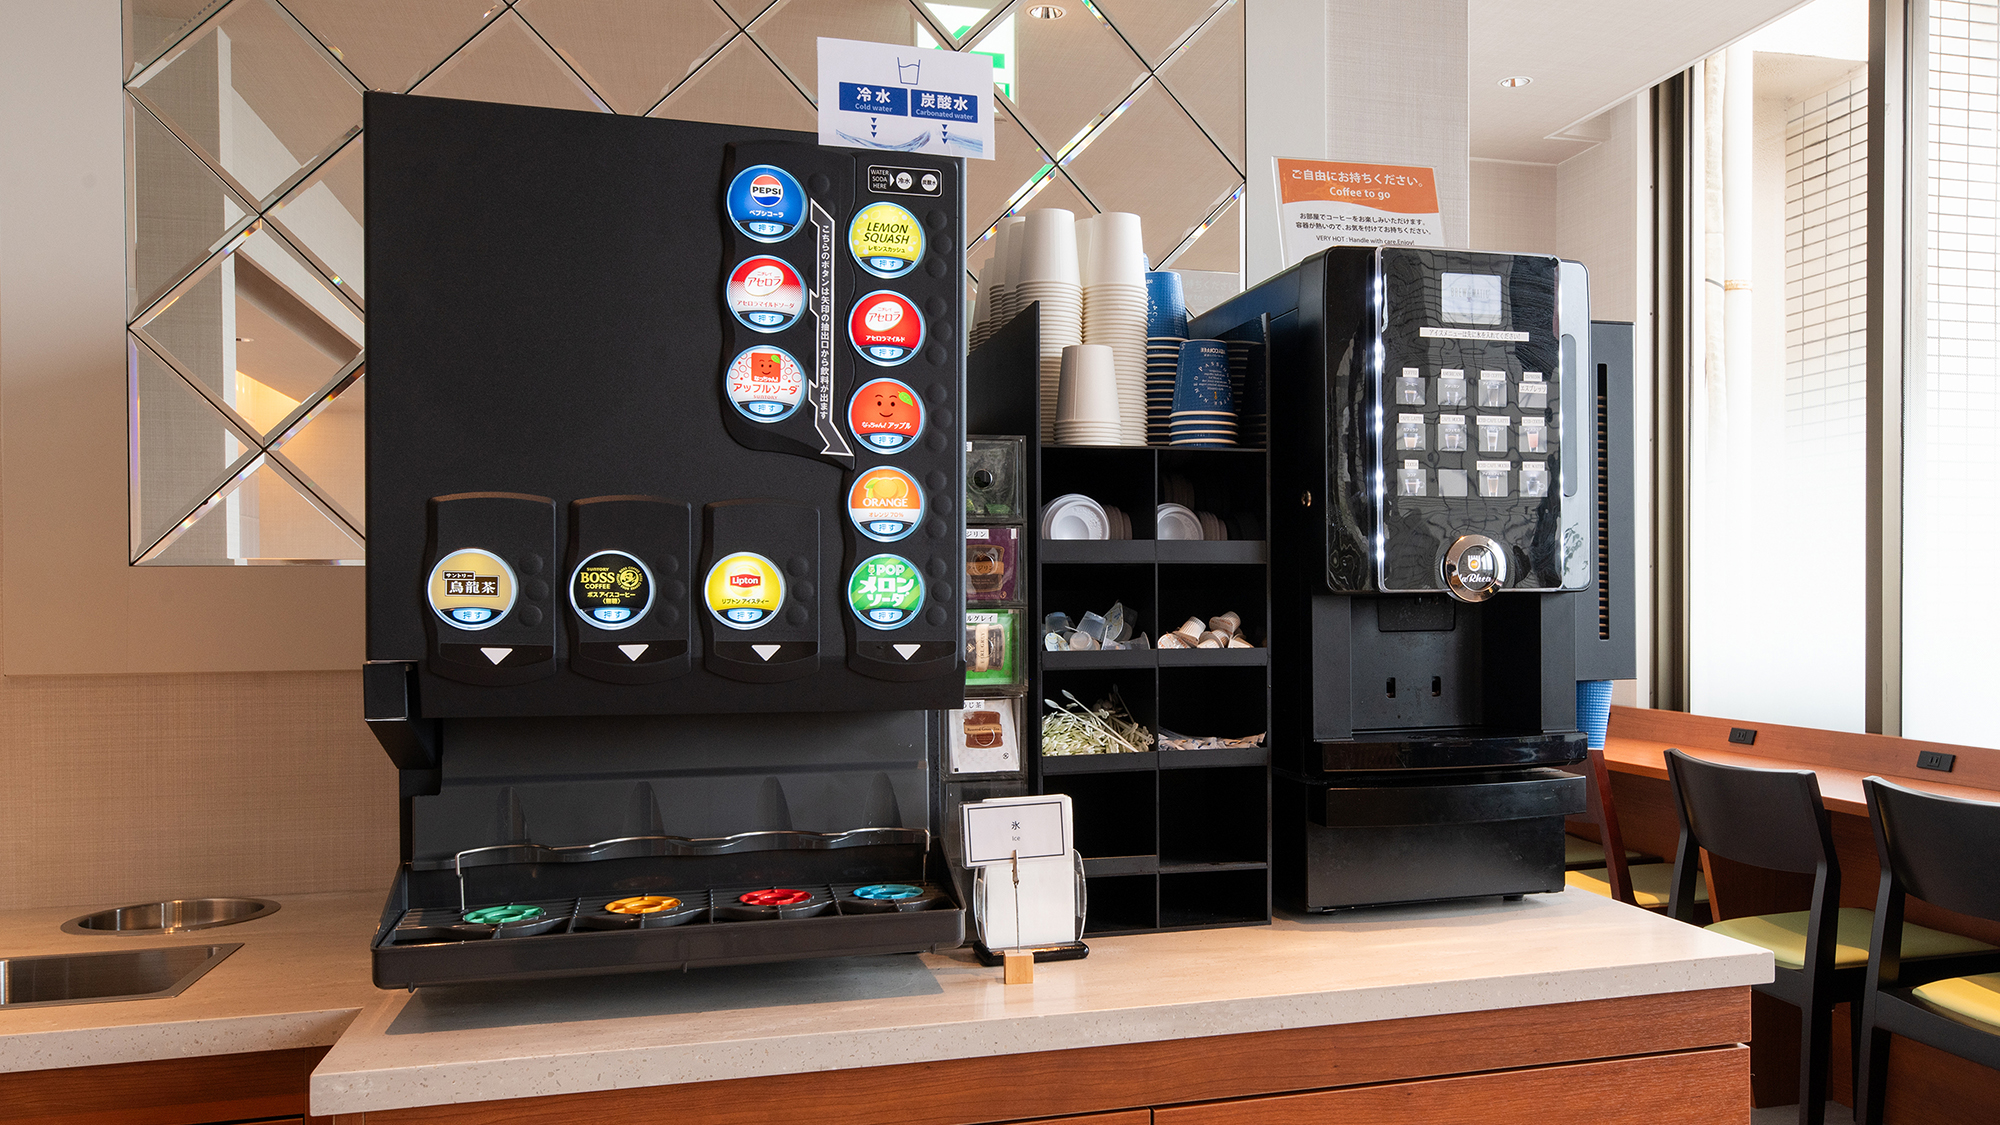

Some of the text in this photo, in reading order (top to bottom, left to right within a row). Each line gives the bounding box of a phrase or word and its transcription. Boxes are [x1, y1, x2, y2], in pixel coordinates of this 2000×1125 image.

[856, 86, 891, 104] 冷水
[920, 92, 969, 111] 炭酸水
[855, 102, 893, 113] Cold water
[915, 108, 974, 121] Carbonated water
[1291, 168, 1424, 188] ご自由にお持ちください。
[752, 186, 781, 195] PEPSI
[1329, 186, 1391, 200] Coffee to go
[749, 210, 784, 218] ペプシコーラ
[758, 224, 776, 232] 押す
[866, 222, 909, 234] LEMON
[863, 232, 910, 244] SQUASH
[879, 260, 896, 268] 押す
[748, 276, 781, 287] アセロラ
[736, 300, 795, 309] アセロラマイルドソーダ
[758, 314, 776, 322] 押す
[868, 311, 901, 322] アセロラ
[820, 225, 830, 420] こちらのボタンは矢印の抽出口から飲料が出ます
[878, 348, 896, 356] 押す
[733, 382, 800, 395] アップルソーダ
[758, 404, 776, 412] 押す
[888, 422, 912, 430] アップル
[878, 436, 896, 444] 押す
[862, 498, 909, 508] ORANGE
[878, 524, 896, 532] 押す
[876, 564, 906, 576] POP
[580, 572, 616, 584] BOSS
[732, 577, 759, 586] Lipton
[448, 580, 496, 594] 烏龍茶
[858, 576, 914, 594] メロン
[866, 591, 910, 607] ソーダ
[462, 611, 482, 620] 押す
[604, 611, 622, 619] 押す
[736, 611, 754, 620] 押す
[878, 612, 896, 620] 押す
[1011, 820, 1021, 831] 氷
